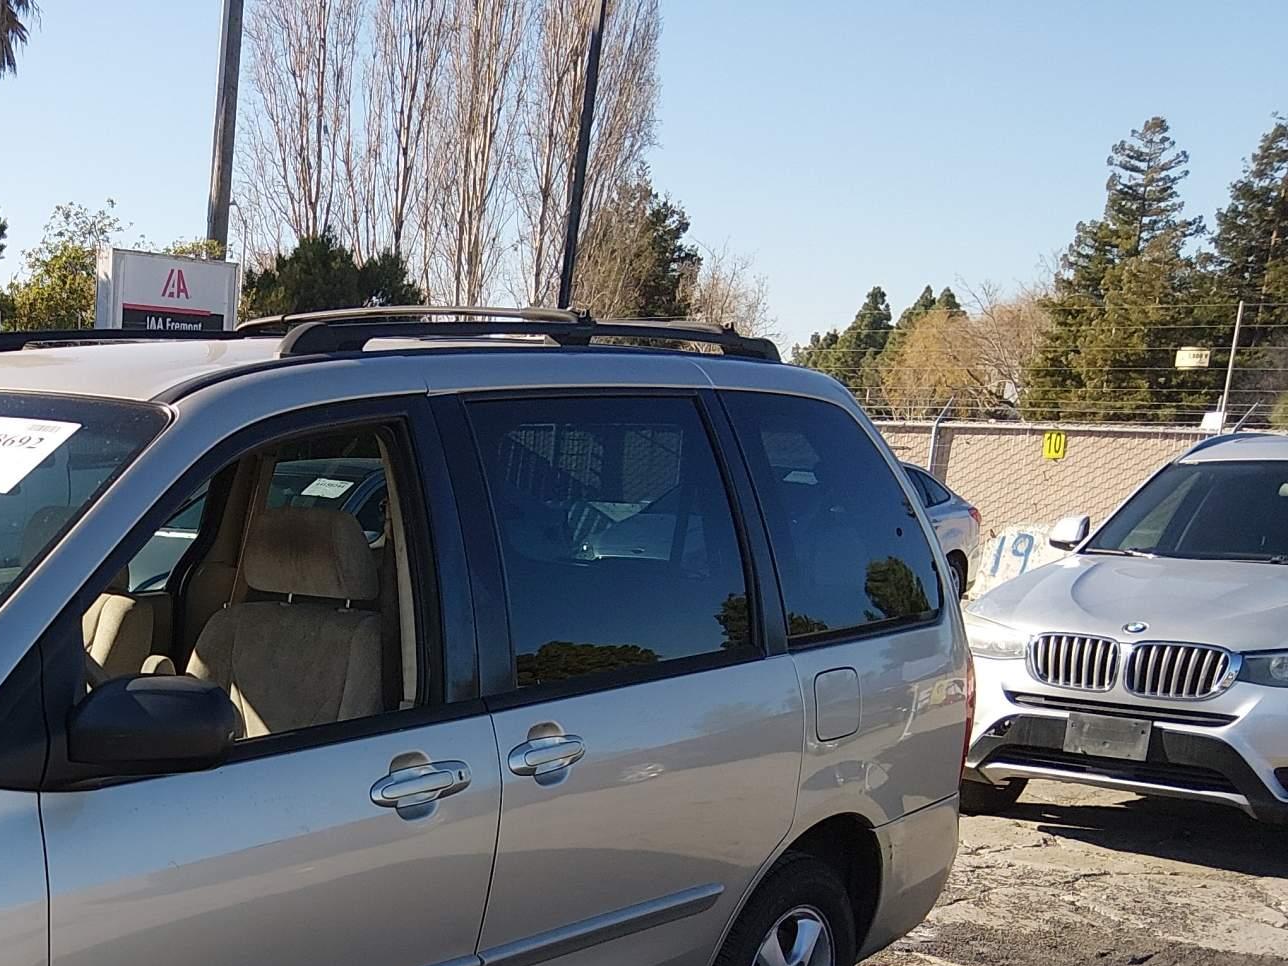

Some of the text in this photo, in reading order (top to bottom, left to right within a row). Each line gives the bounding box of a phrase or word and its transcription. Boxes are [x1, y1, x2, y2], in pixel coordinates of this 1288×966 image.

[146, 315, 202, 331] IAA Fremont
[1047, 432, 1062, 454] 10
[991, 533, 1034, 576] 19
